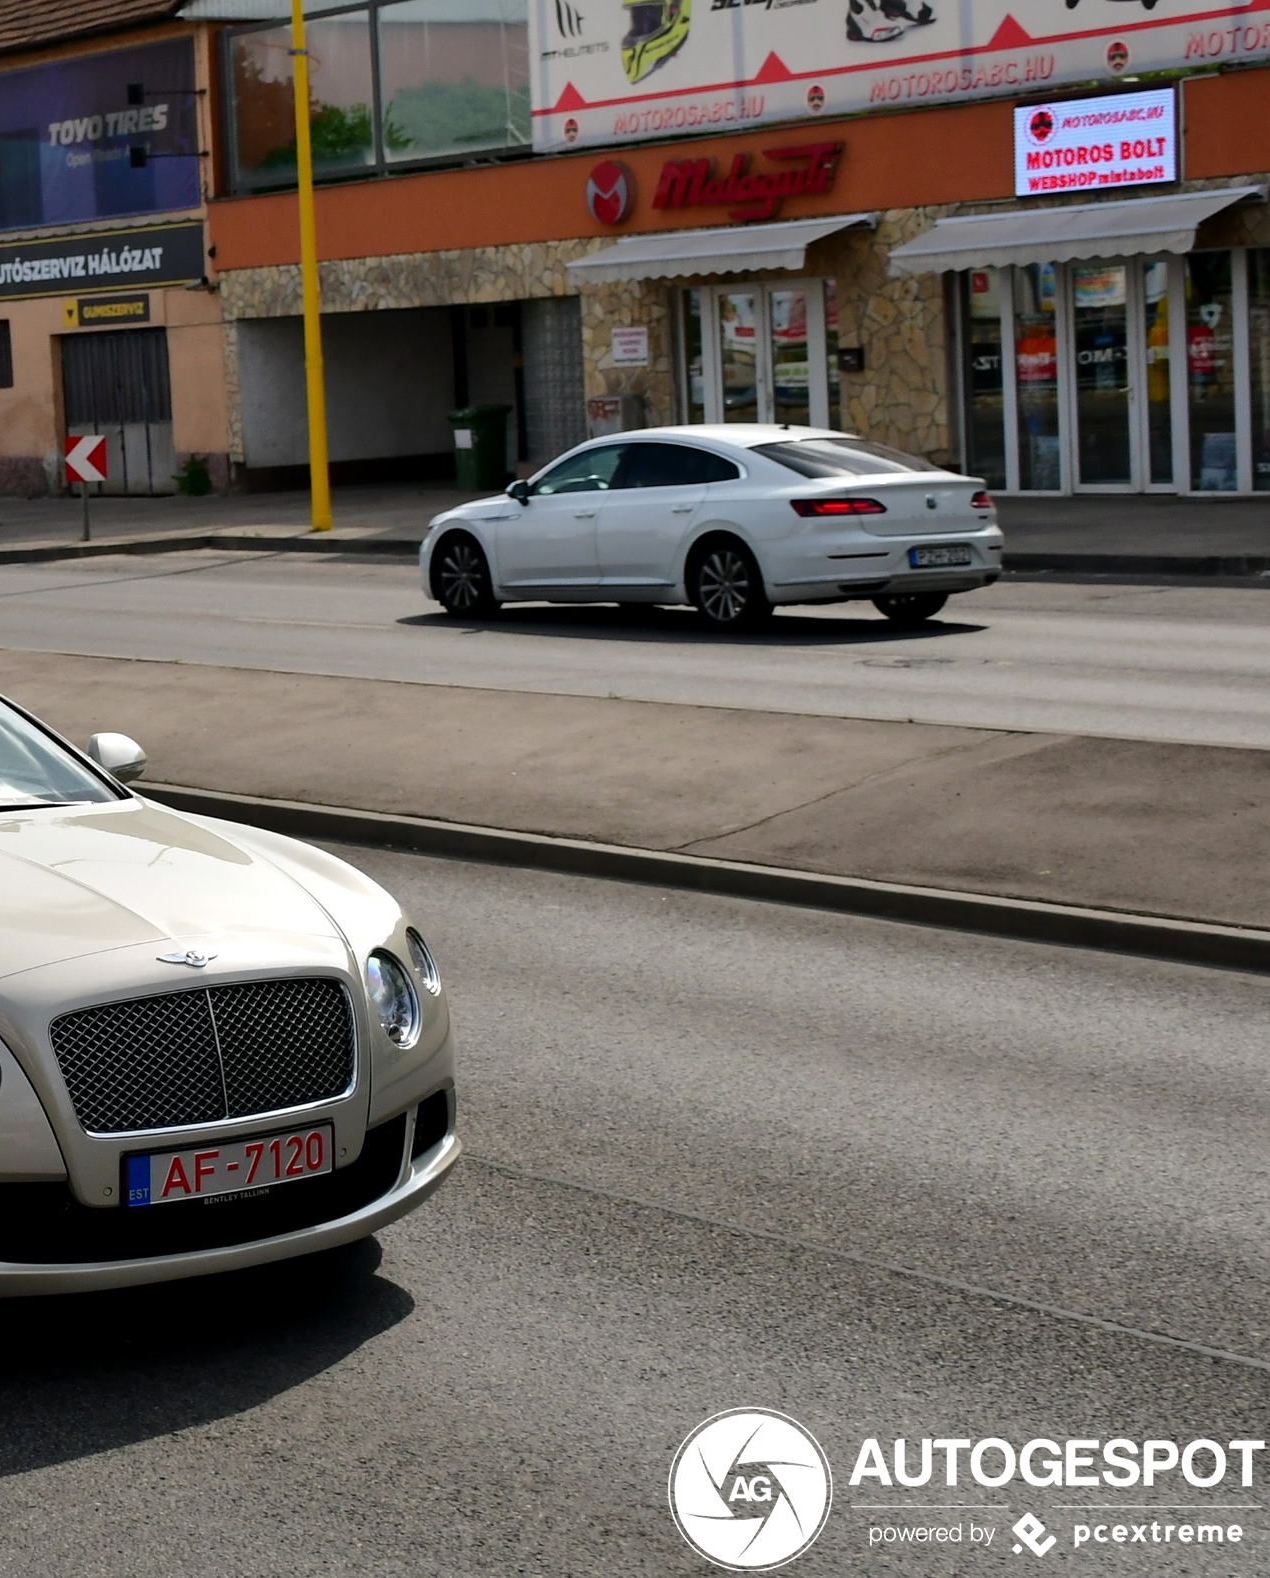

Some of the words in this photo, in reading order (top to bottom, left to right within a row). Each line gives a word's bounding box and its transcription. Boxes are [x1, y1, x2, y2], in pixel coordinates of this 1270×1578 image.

[869, 54, 1055, 102] MOTOROSABC.HU
[49, 114, 103, 147] TOYO
[104, 104, 168, 137] TIRES
[613, 95, 765, 135] MOTOROSABC.HU
[1026, 142, 1114, 170] MOTOROS
[1120, 136, 1166, 161] BOLT
[653, 142, 839, 220] Malaguti
[1029, 171, 1096, 191] WEBSHOP
[88, 245, 163, 275] HÁLÓZAT
[161, 1131, 324, 1198] AF-7120
[129, 1187, 150, 1200] EST
[204, 1193, 238, 1205] BENTLEY
[240, 1187, 270, 1199] TALLINN
